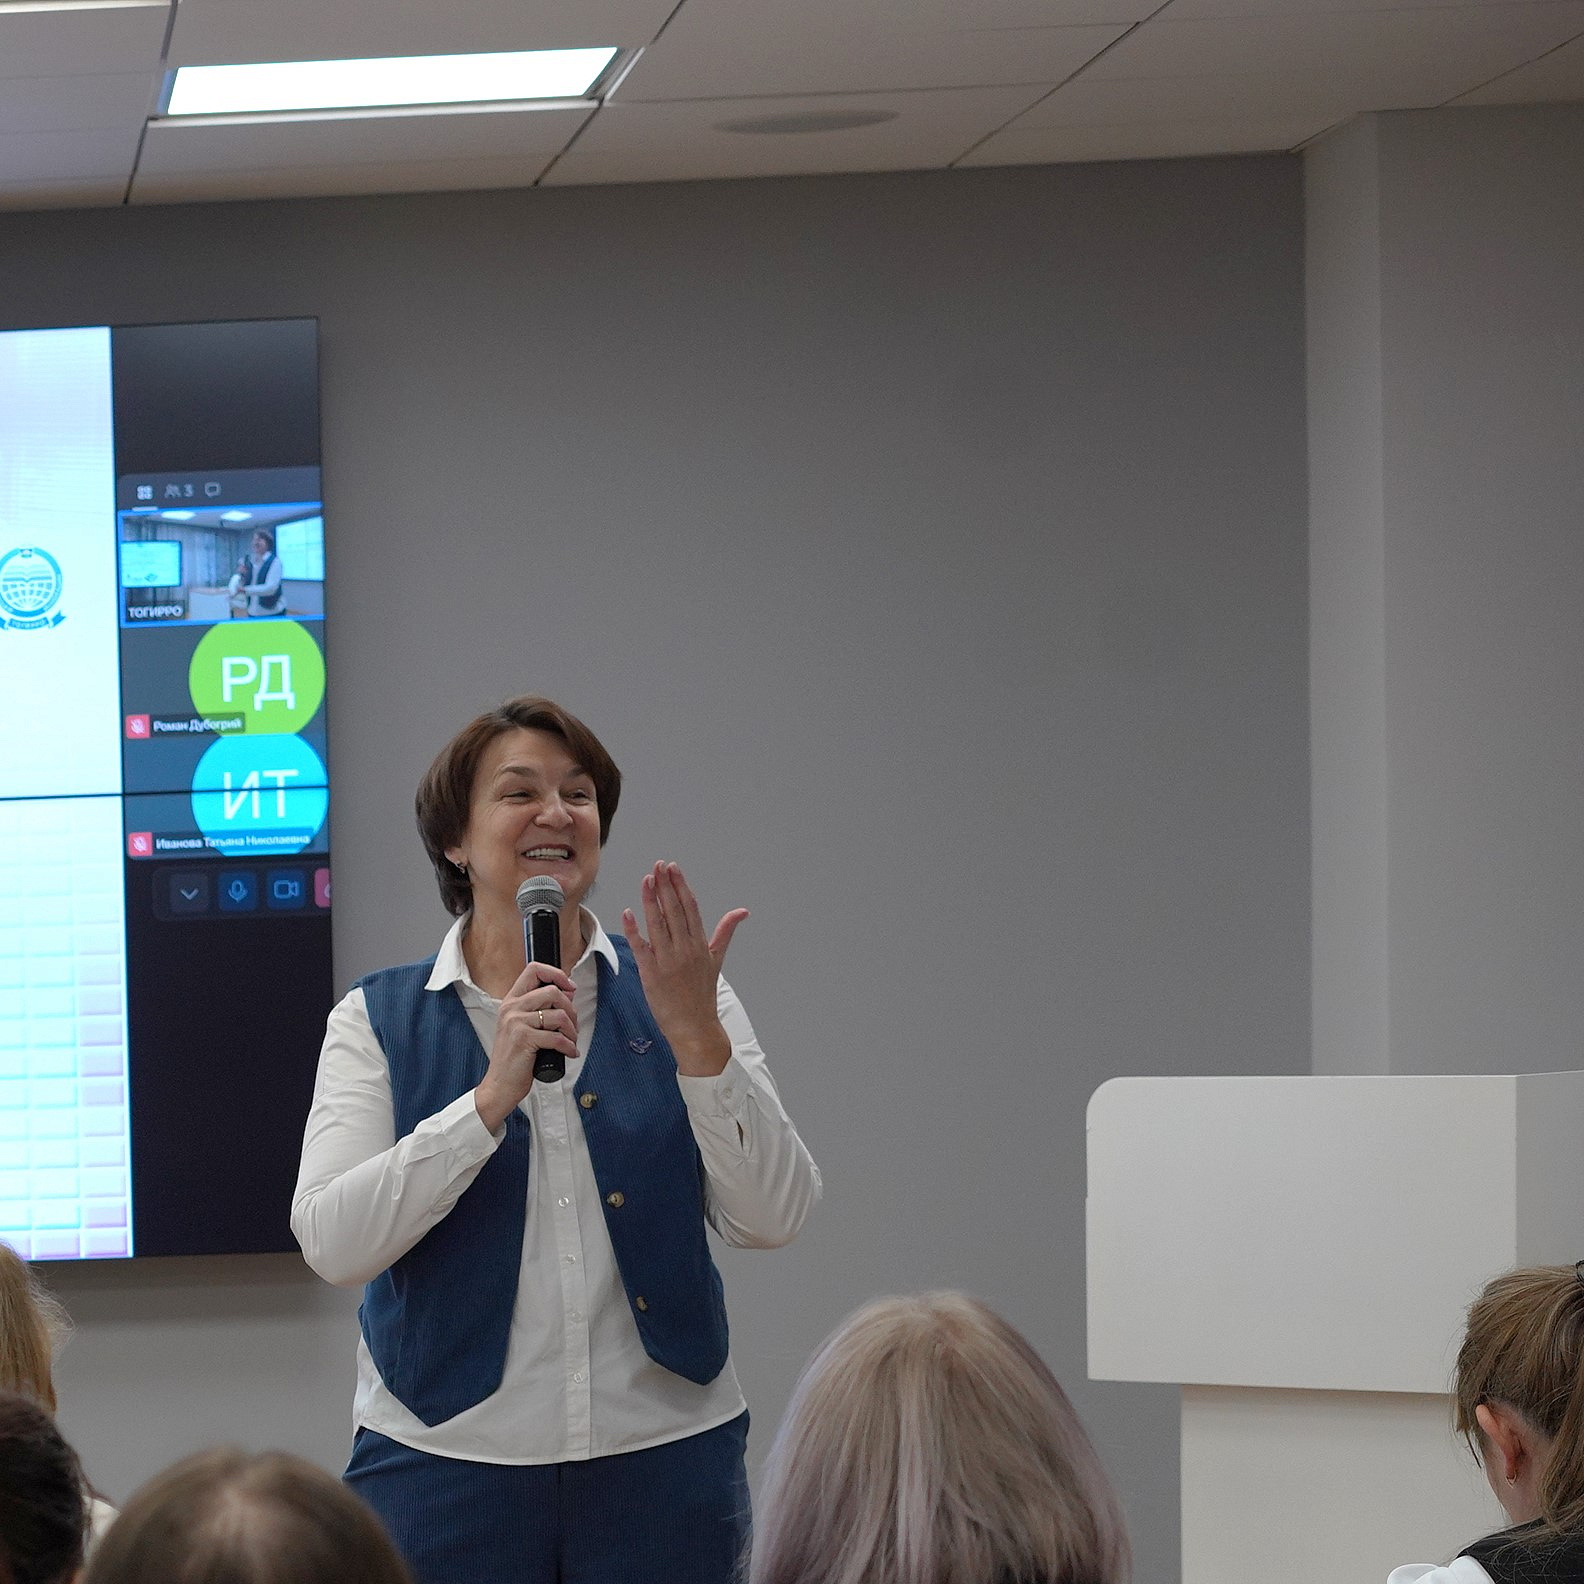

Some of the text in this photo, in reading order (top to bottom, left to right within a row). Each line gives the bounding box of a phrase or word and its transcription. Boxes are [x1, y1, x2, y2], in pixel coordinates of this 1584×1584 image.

[128, 605, 183, 618] ТОГИРРО
[221, 655, 296, 712] РД
[153, 721, 188, 731] Роман
[223, 769, 299, 820] ИТ
[156, 834, 310, 849] Иванова Татьяна Николаевна
